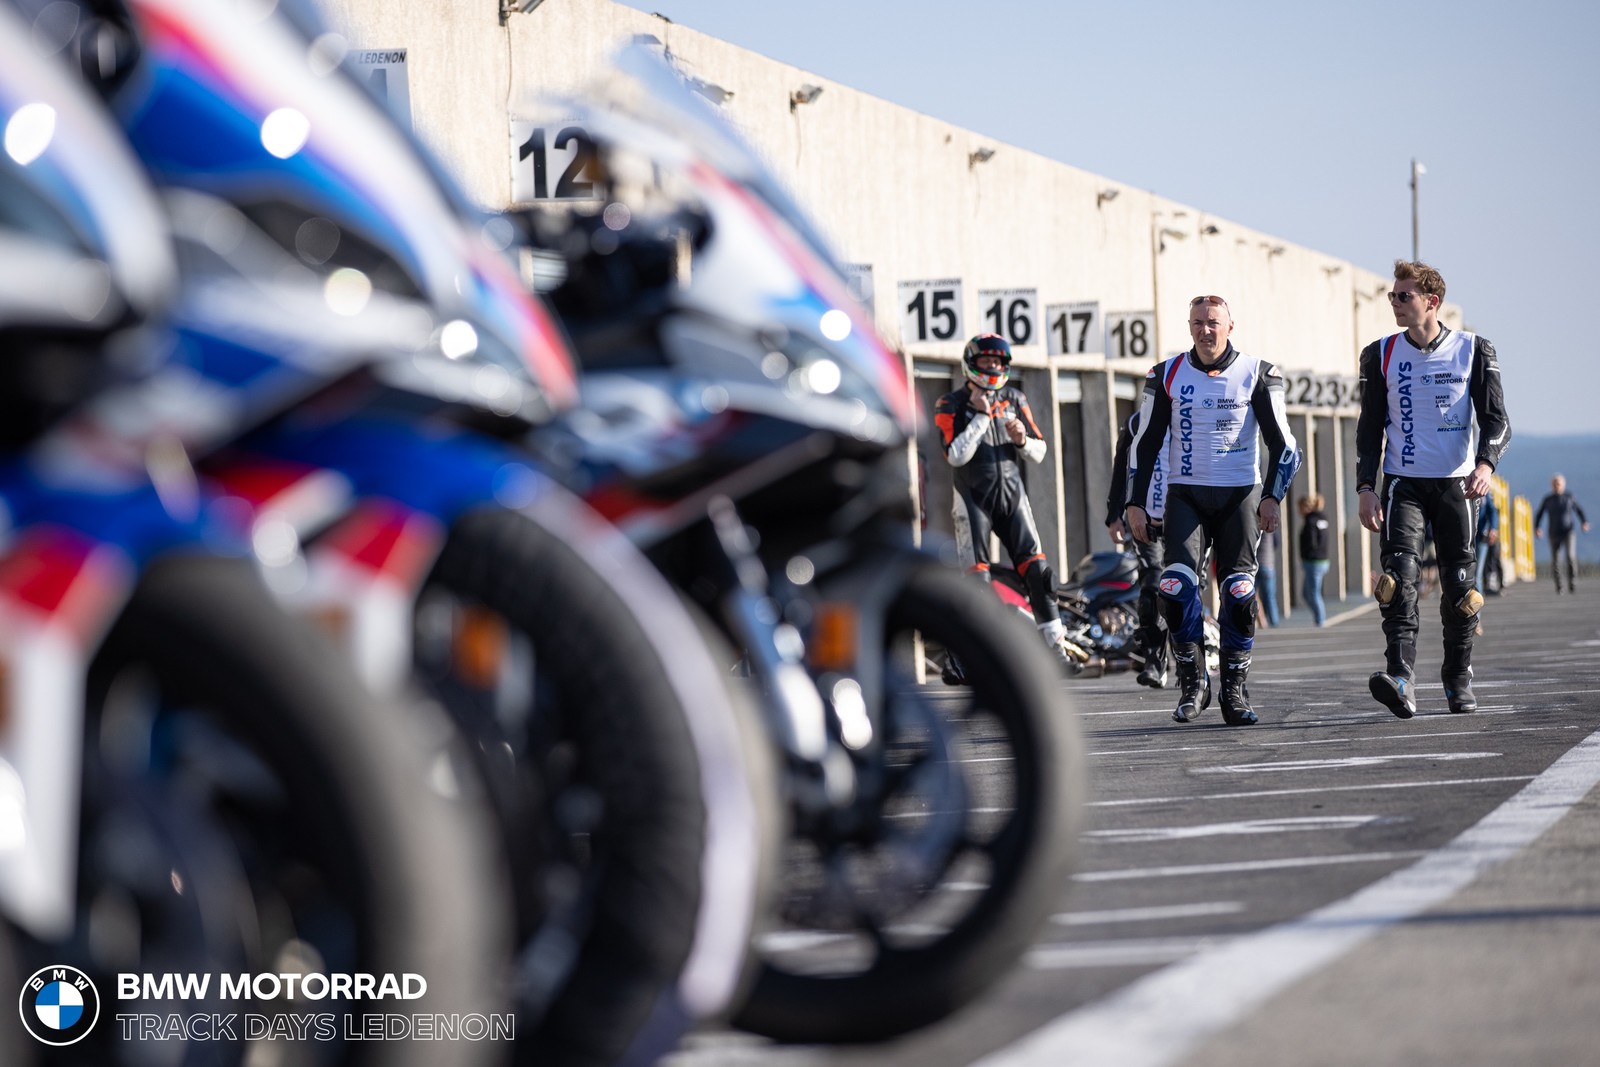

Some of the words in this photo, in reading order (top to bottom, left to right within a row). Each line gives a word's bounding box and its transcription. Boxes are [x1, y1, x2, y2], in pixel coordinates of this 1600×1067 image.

[359, 51, 406, 64] LEDENON
[519, 126, 593, 199] 12
[907, 290, 957, 340] 15
[986, 299, 1031, 345] 16
[1052, 312, 1092, 354] 17
[1111, 319, 1148, 358] 18
[1398, 361, 1415, 467] TRACKDAYS
